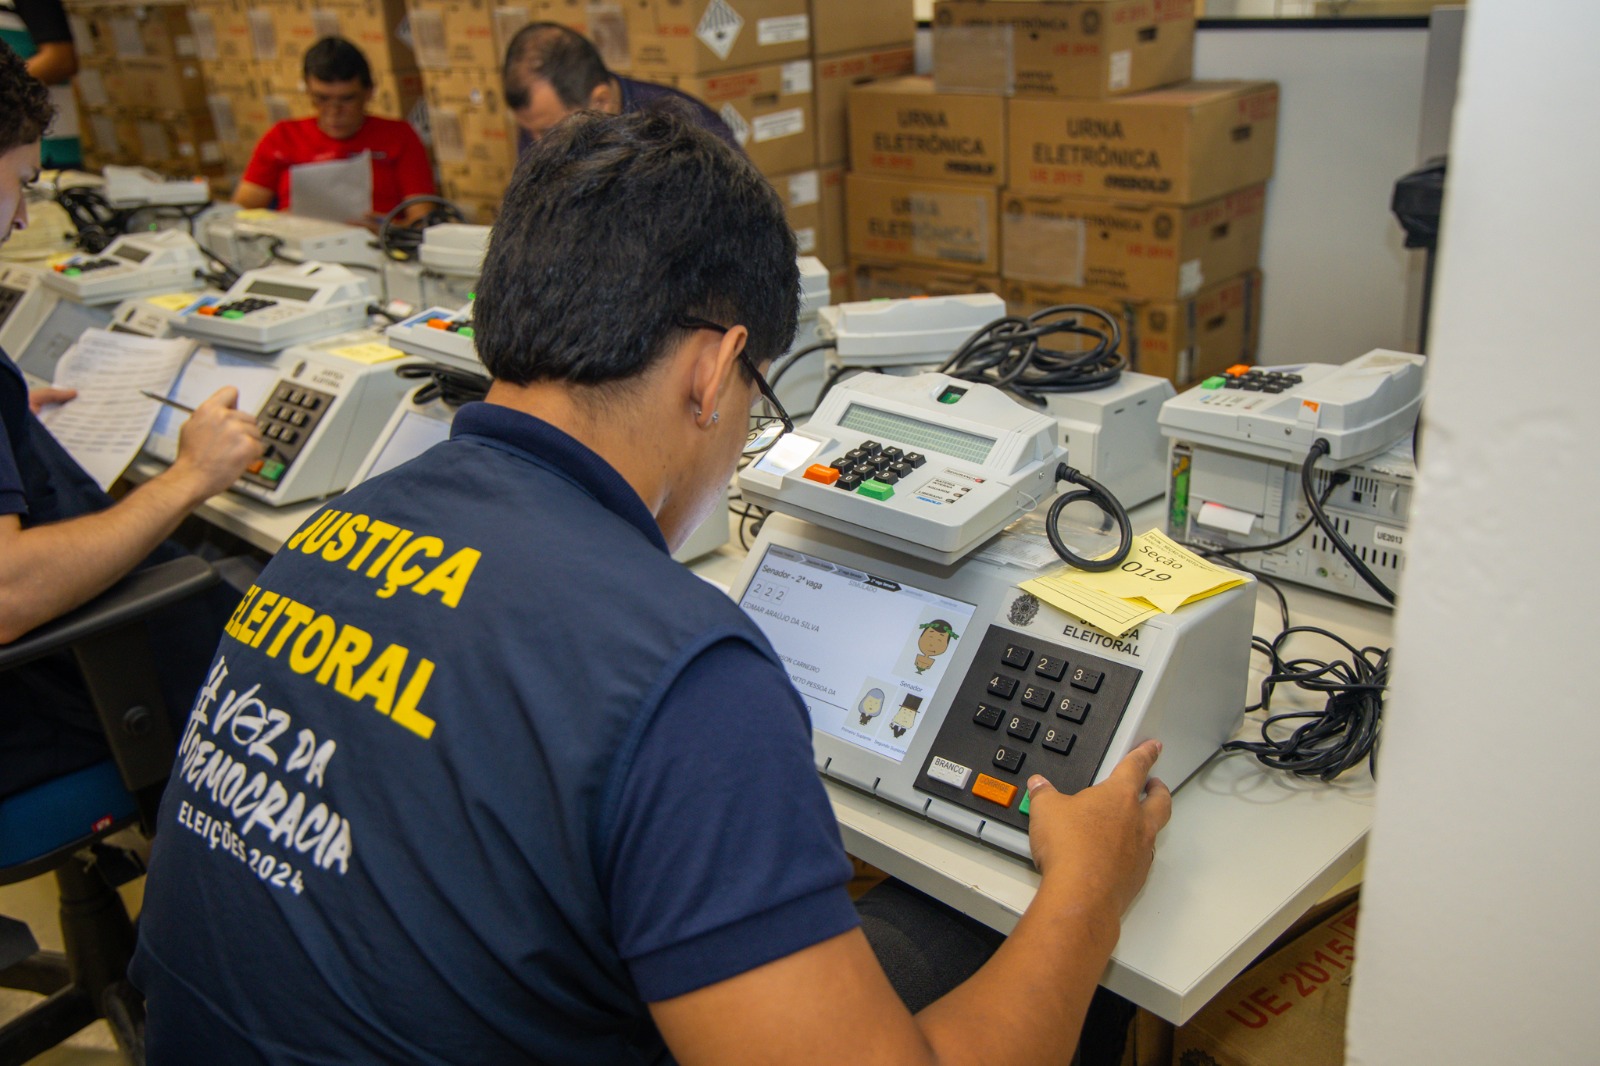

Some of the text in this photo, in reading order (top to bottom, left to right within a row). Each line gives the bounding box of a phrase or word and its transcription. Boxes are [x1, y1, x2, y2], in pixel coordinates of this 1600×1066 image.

[897, 109, 948, 128] URNA
[1066, 117, 1125, 139] URNA
[873, 132, 985, 155] ELETRÔNICA
[1033, 142, 1160, 170] ELETRÔNICA
[288, 509, 481, 608] JUSTIÇA
[1138, 545, 1183, 570] Seção
[762, 564, 790, 580] Senador
[806, 580, 823, 590] vaga
[1121, 562, 1172, 582] 019
[753, 584, 784, 600] 2 2 2
[848, 580, 878, 592] SIMULADO
[742, 602, 764, 613] EDMAR
[790, 618, 800, 626] DA
[800, 620, 820, 632] SILVA
[1062, 624, 1140, 658] ELEITORAL
[1006, 648, 1013, 658] 1
[225, 585, 436, 739] ELEITORAL
[792, 660, 820, 674] CARNEIRO
[1038, 659, 1048, 669] 2
[990, 677, 998, 687] 4
[1074, 670, 1082, 680] 3
[806, 680, 828, 693] PESSOA
[828, 688, 836, 696] DA
[900, 680, 924, 692] Senador
[1024, 688, 1033, 699] 5
[977, 706, 985, 716] 7
[1060, 699, 1069, 710] 6
[1010, 718, 1019, 729] 8
[1046, 730, 1055, 742] 9
[286, 728, 336, 788] DA
[996, 750, 1004, 760] 0
[934, 758, 964, 774] BRANCO
[980, 776, 1009, 792] CORRIGE
[180, 732, 352, 875] DEMOCRACIA
[178, 800, 304, 895] ELEIÇÕES 2024
[1225, 938, 1357, 1029] UE 2015
